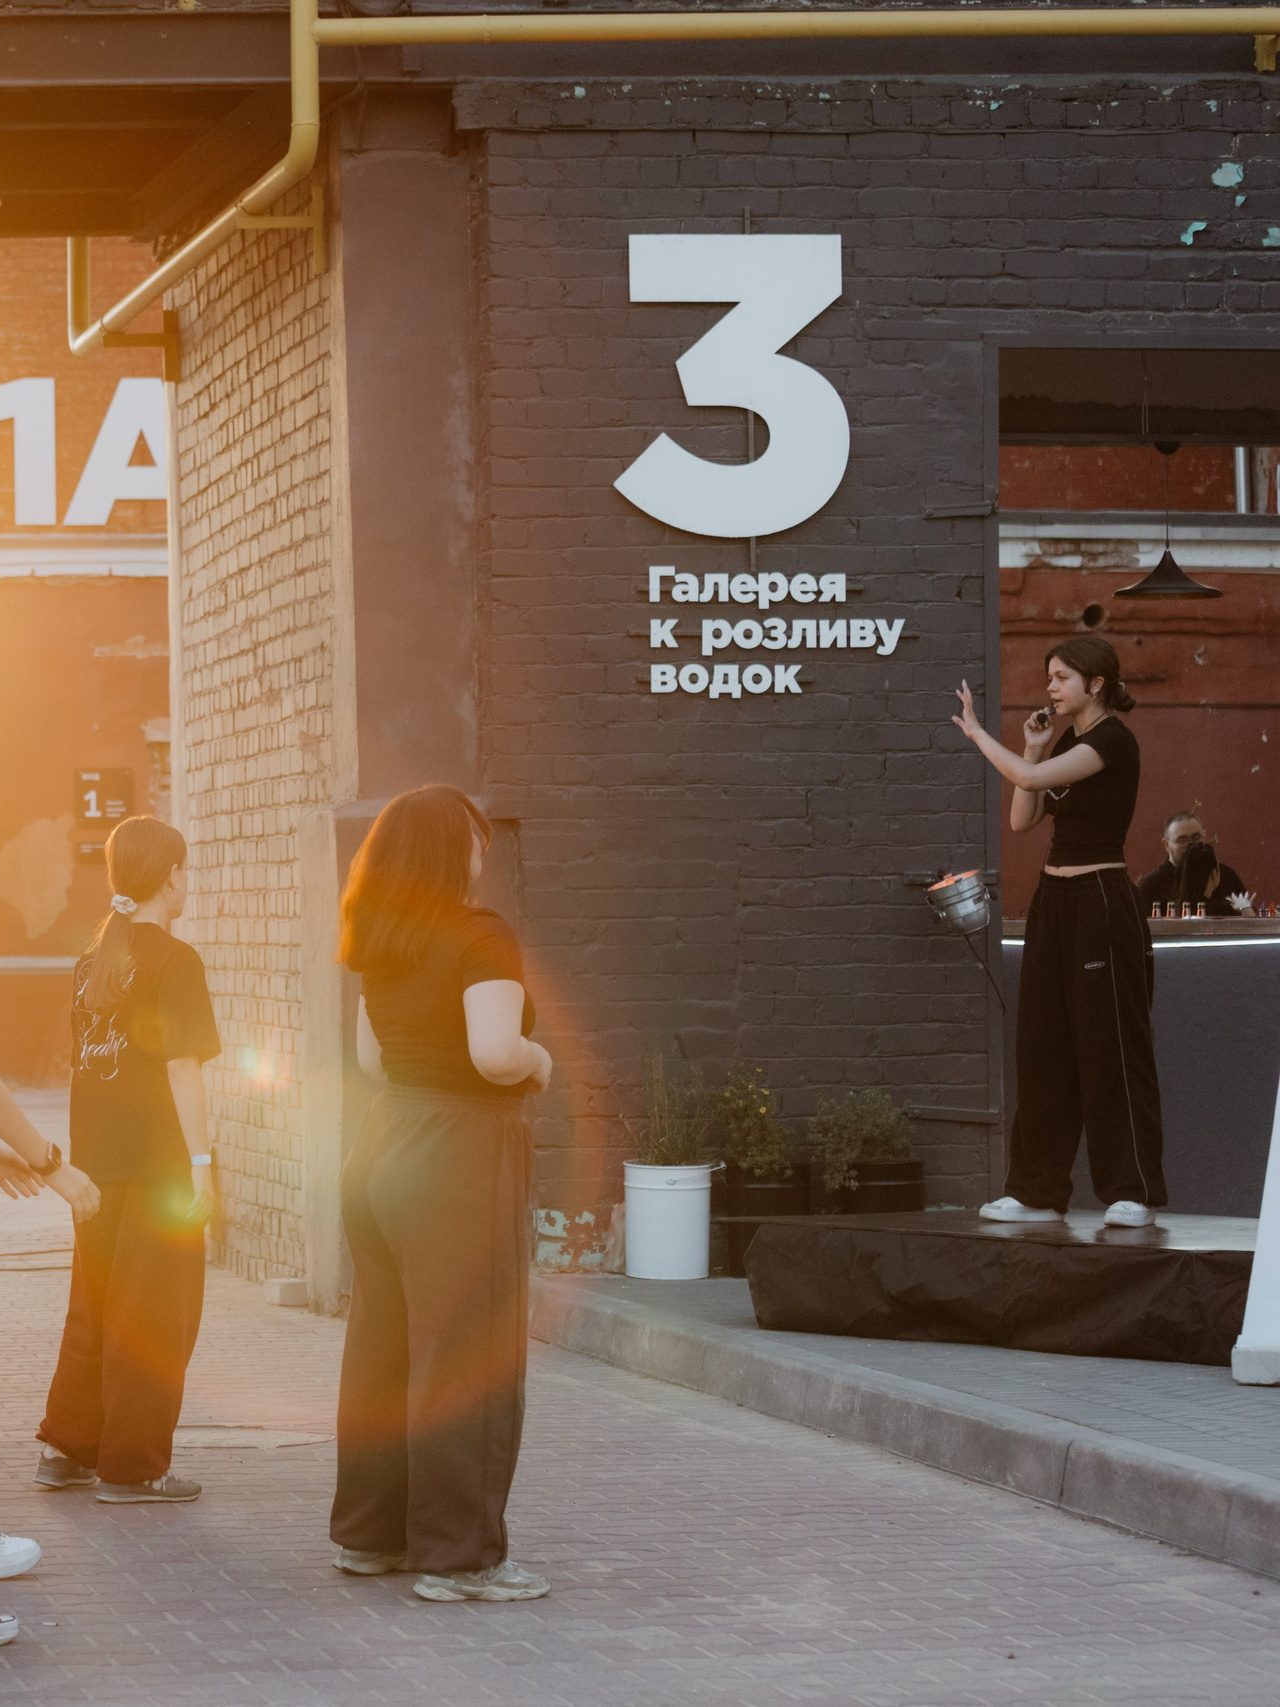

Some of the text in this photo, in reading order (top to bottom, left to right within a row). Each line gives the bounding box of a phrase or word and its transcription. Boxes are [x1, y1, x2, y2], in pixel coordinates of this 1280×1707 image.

[613, 234, 850, 537] 3
[648, 565, 847, 609] Галерея
[650, 617, 906, 656] к розливу
[650, 663, 803, 698] водок
[83, 790, 102, 817] 1
